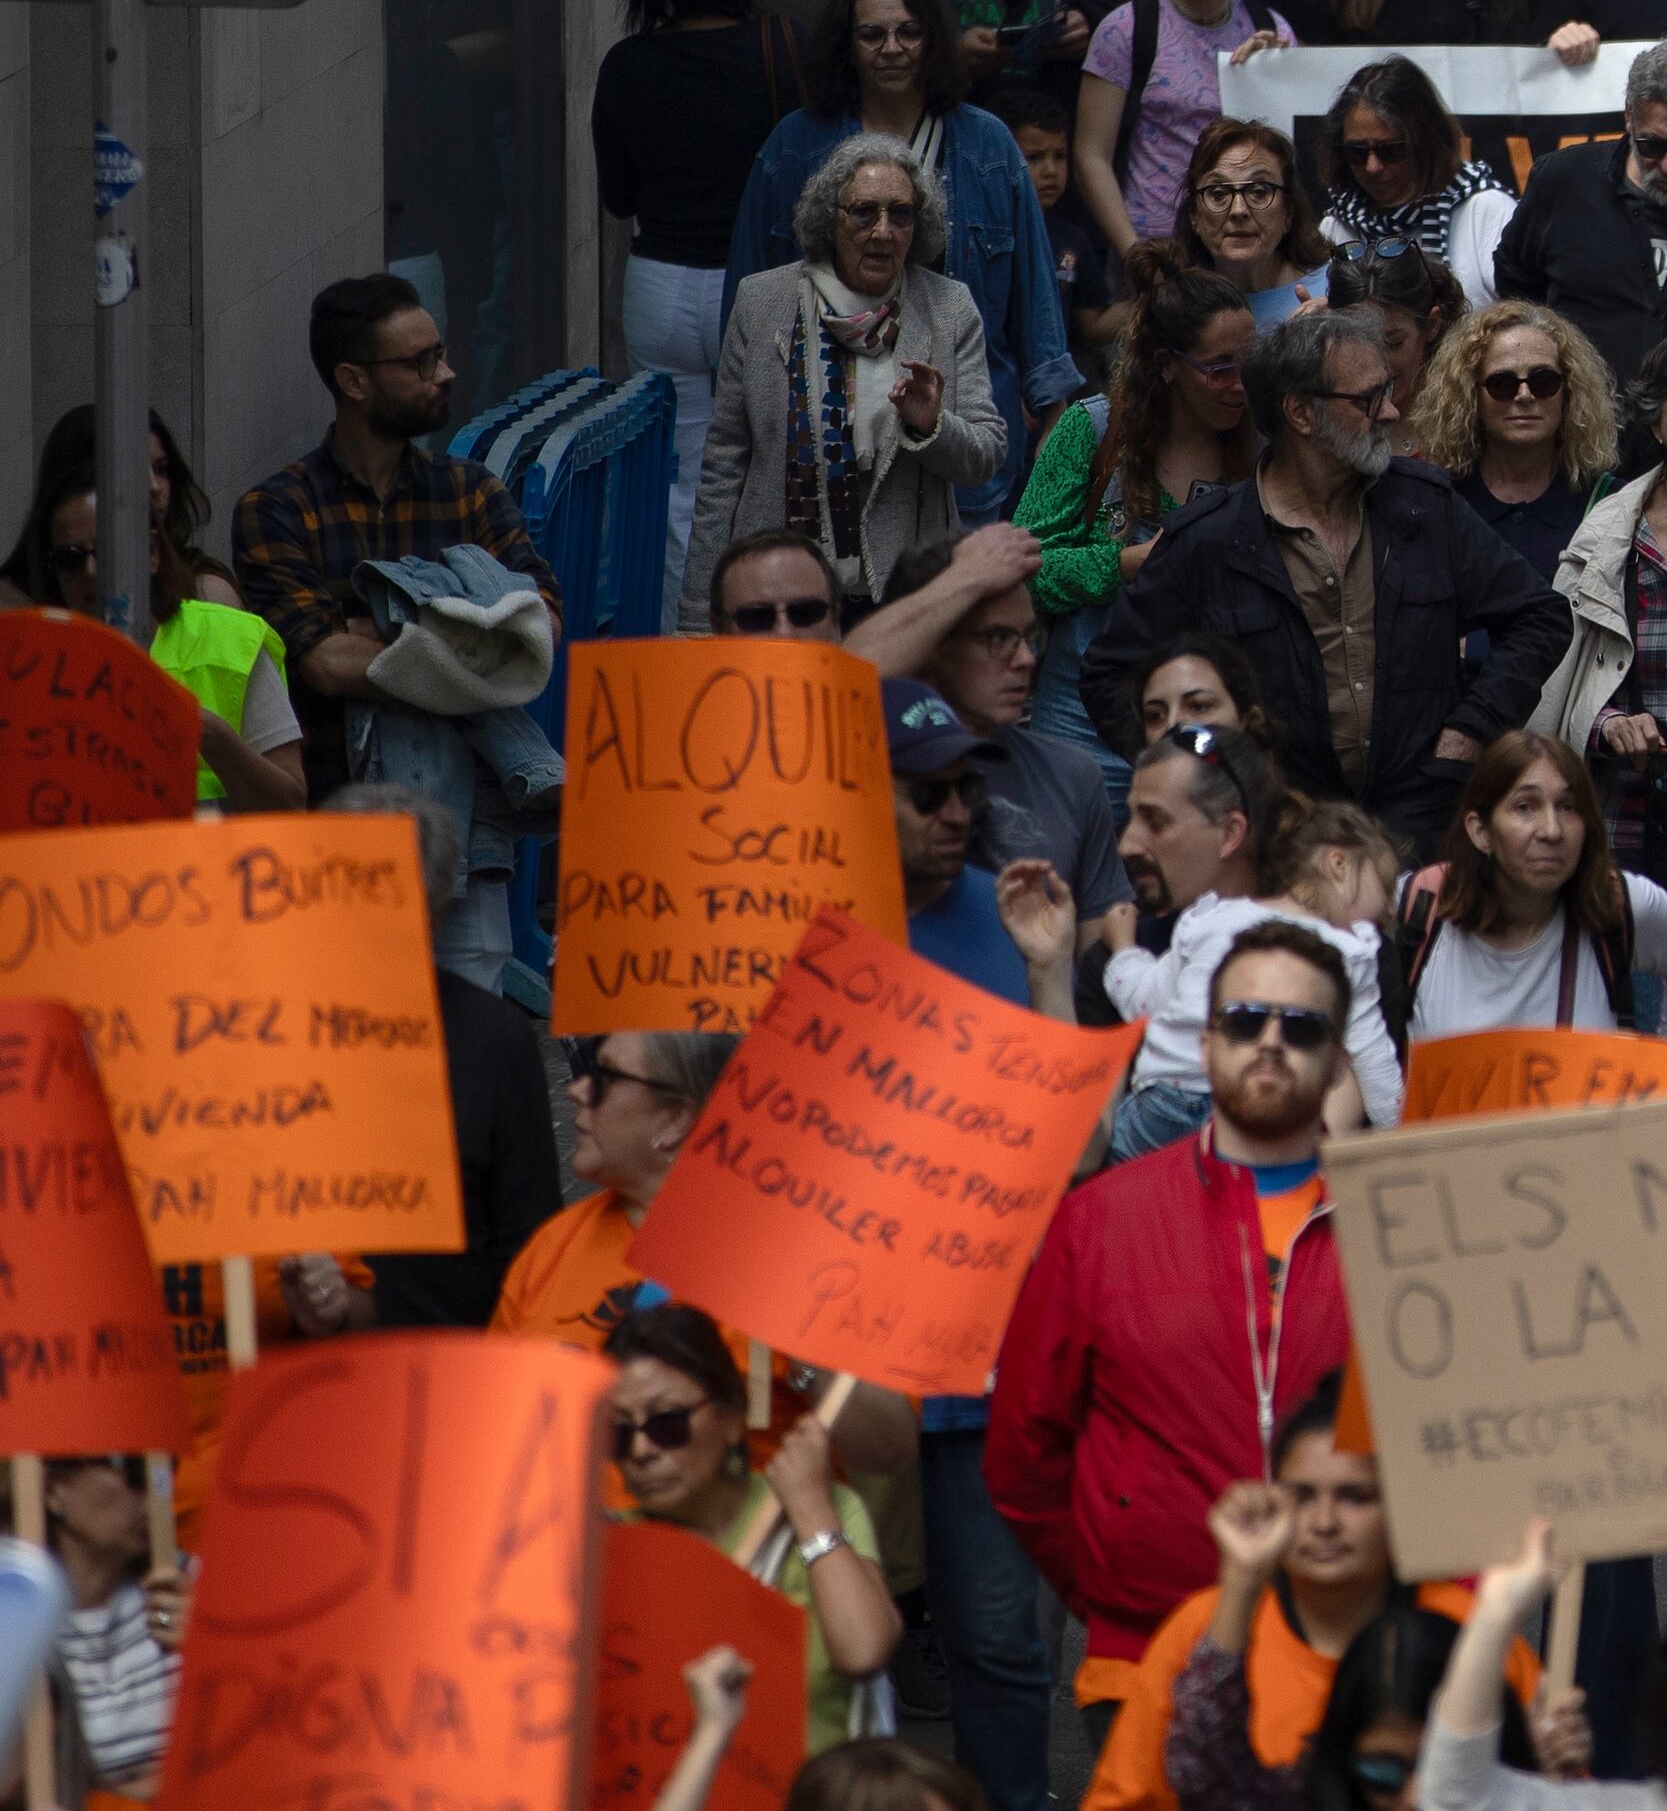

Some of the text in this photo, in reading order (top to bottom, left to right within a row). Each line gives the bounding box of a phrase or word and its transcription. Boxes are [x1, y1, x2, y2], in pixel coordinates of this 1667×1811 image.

[562, 870, 679, 929] PARA
[172, 994, 287, 1056] DEL
[799, 907, 980, 1054] ZONAS
[846, 1045, 1036, 1150] MALLORCA
[692, 1118, 902, 1253] ALQUILER
[1364, 1159, 1567, 1270] ELS
[1385, 1279, 1456, 1381] O
[1510, 1263, 1640, 1362] LA
